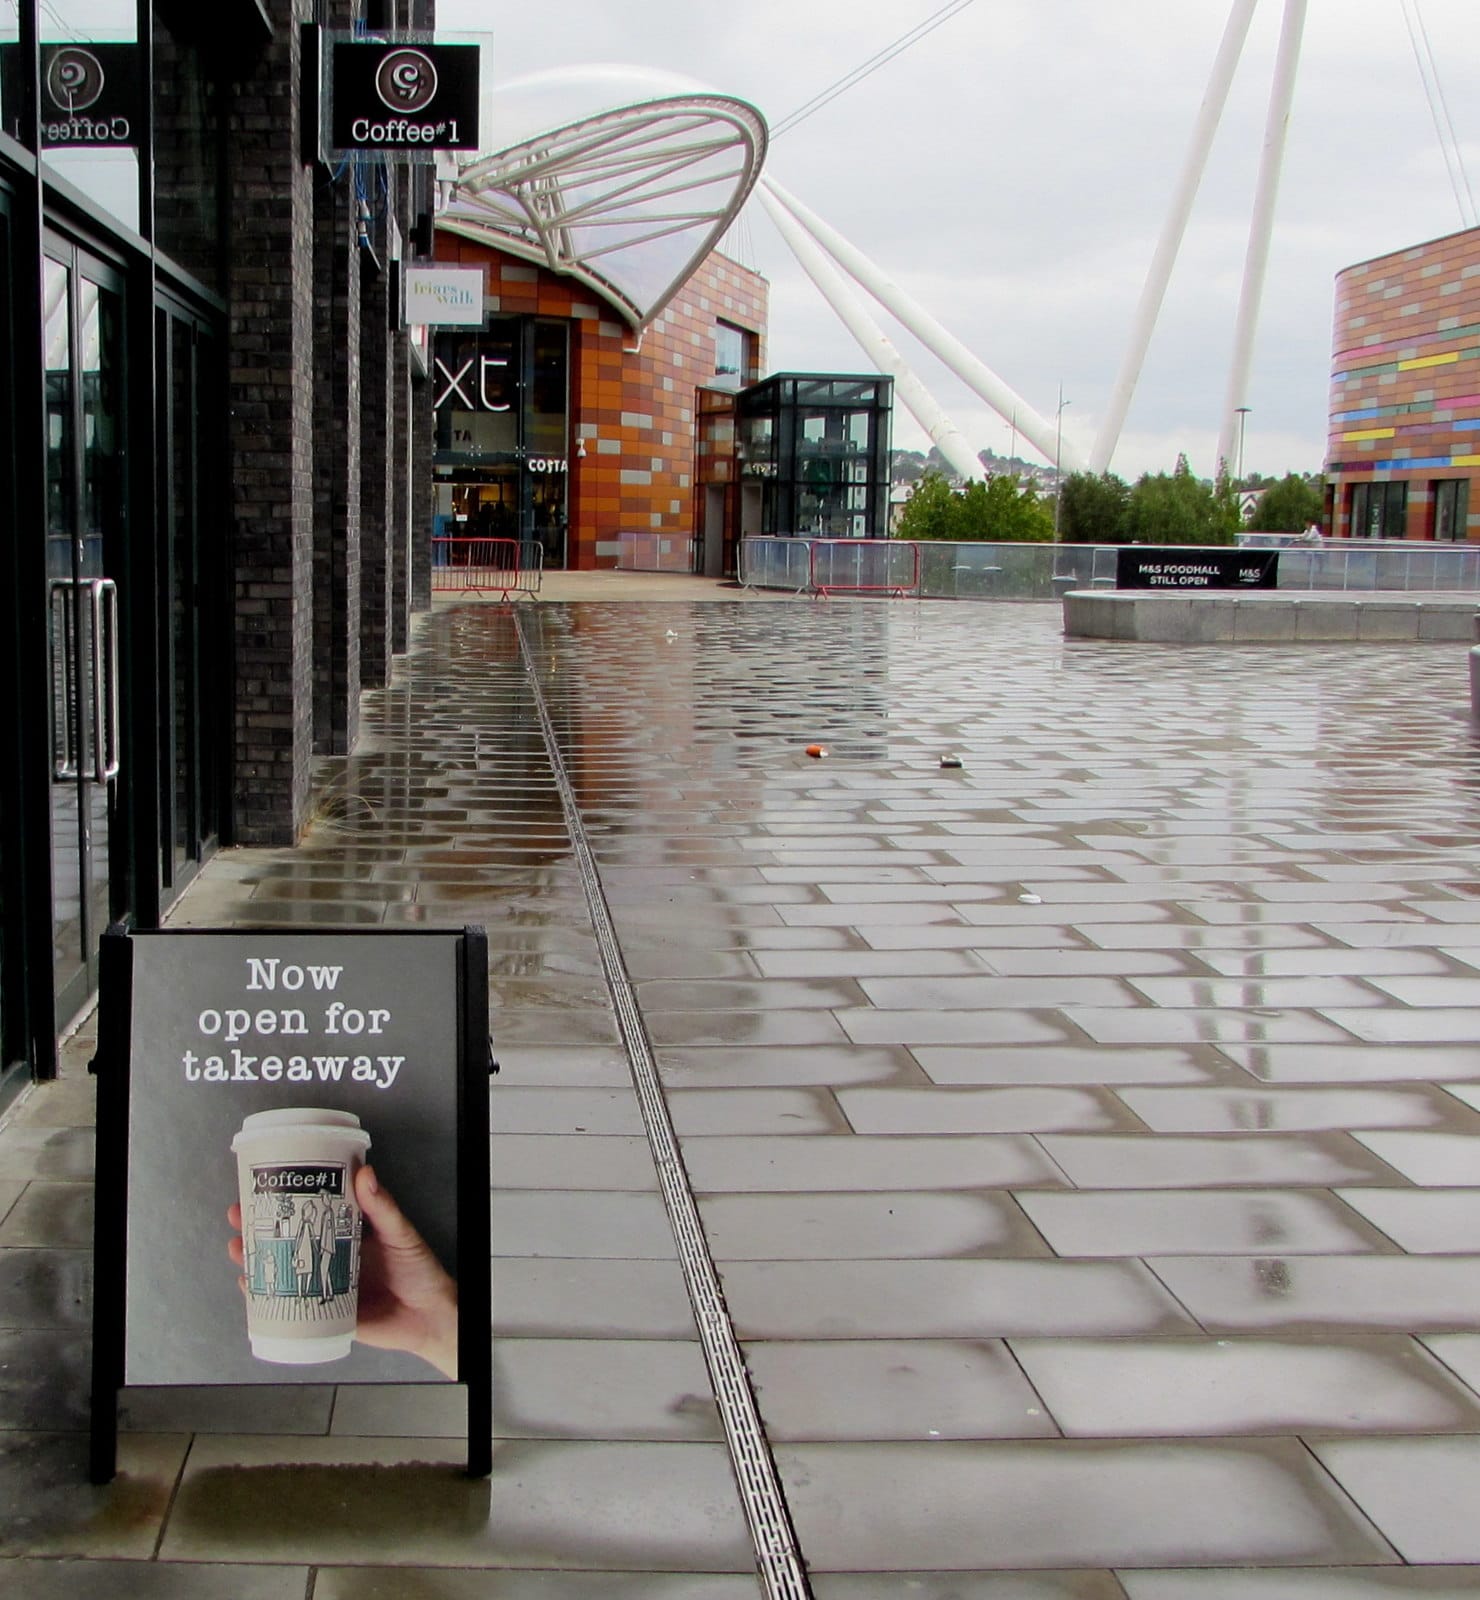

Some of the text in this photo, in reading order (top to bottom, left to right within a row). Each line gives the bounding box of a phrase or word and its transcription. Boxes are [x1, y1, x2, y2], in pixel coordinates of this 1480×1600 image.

[352, 119, 460, 143] Coffee#1
[434, 355, 511, 412] xt
[528, 459, 569, 474] COSTA
[1138, 564, 1221, 576] M&S FOODHALL
[1238, 568, 1261, 578] M&S
[1150, 576, 1209, 585] STILL OPEN
[245, 957, 344, 991] Now
[198, 1001, 391, 1042] open for
[182, 1048, 406, 1089] takeaway
[256, 1171, 338, 1188] Coffee#1
